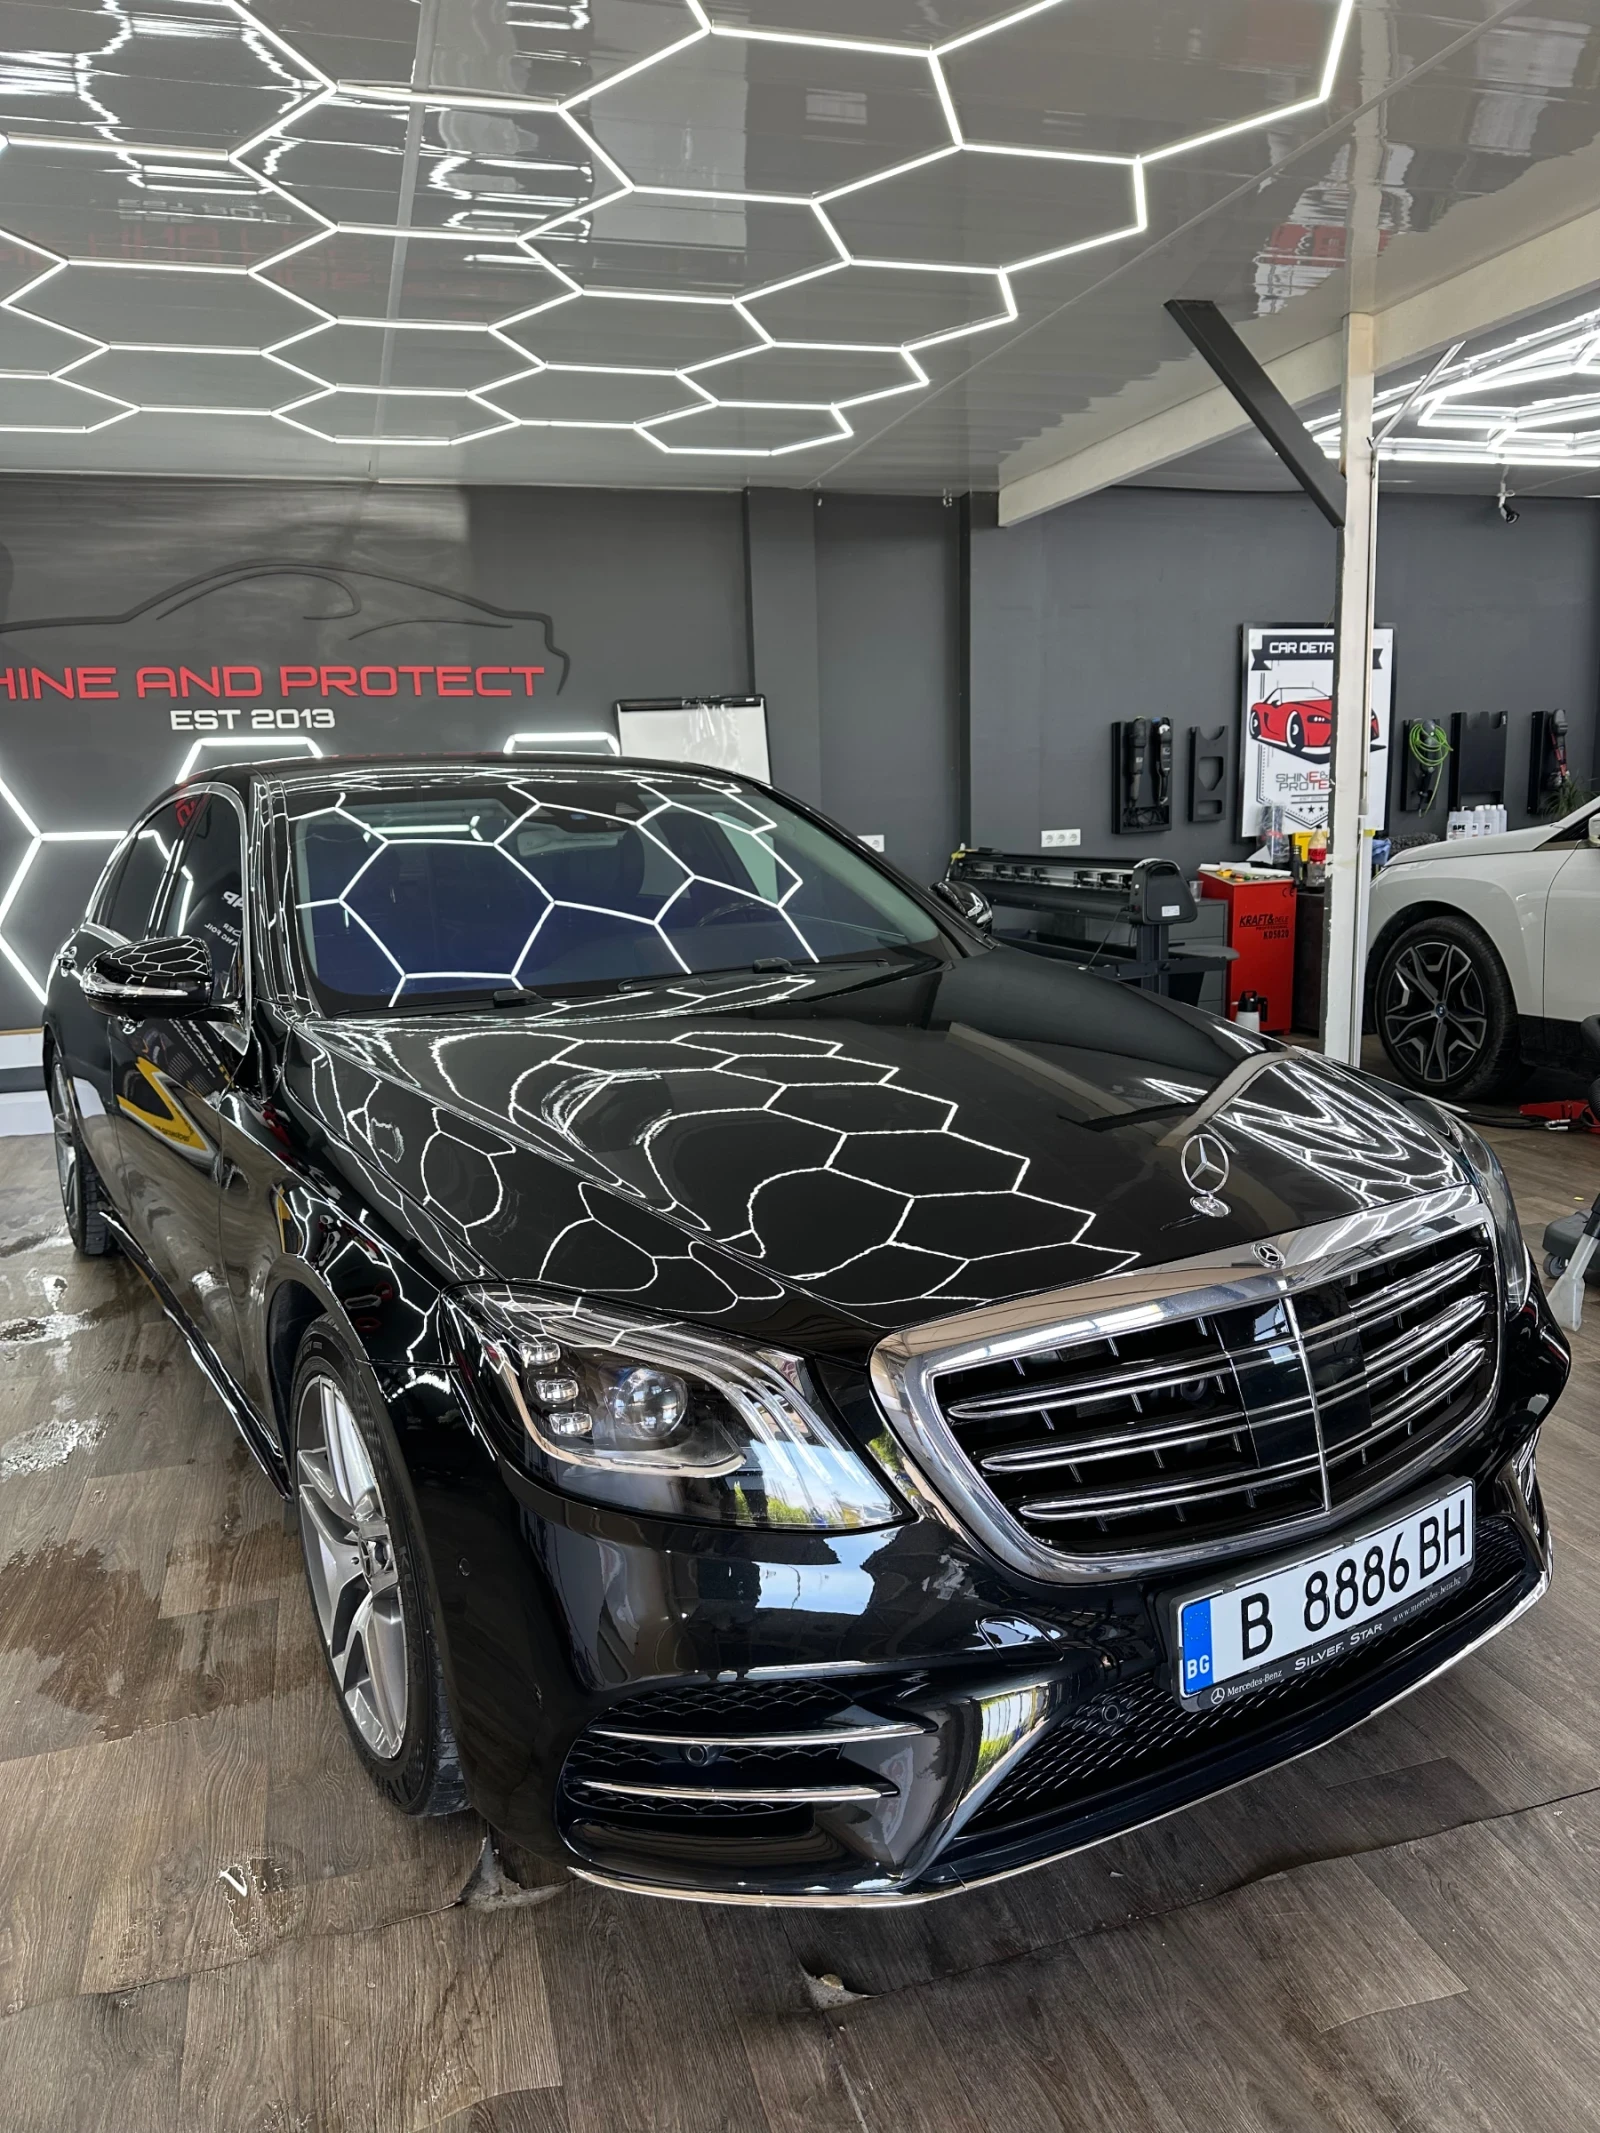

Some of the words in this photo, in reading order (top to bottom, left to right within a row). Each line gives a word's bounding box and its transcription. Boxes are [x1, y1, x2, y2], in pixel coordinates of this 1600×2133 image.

[1269, 641, 1297, 654] CAR
[136, 666, 263, 698] AND
[280, 666, 545, 697] PROTECT
[170, 709, 241, 730] EST
[251, 708, 336, 730] 2013
[1240, 1592, 1273, 1661] B
[1303, 1531, 1410, 1632] 8886
[1419, 1499, 1465, 1580] BH
[1186, 1654, 1210, 1680] BG
[1227, 1669, 1283, 1698] Mercedes-Benz
[1350, 1623, 1383, 1646] STAR
